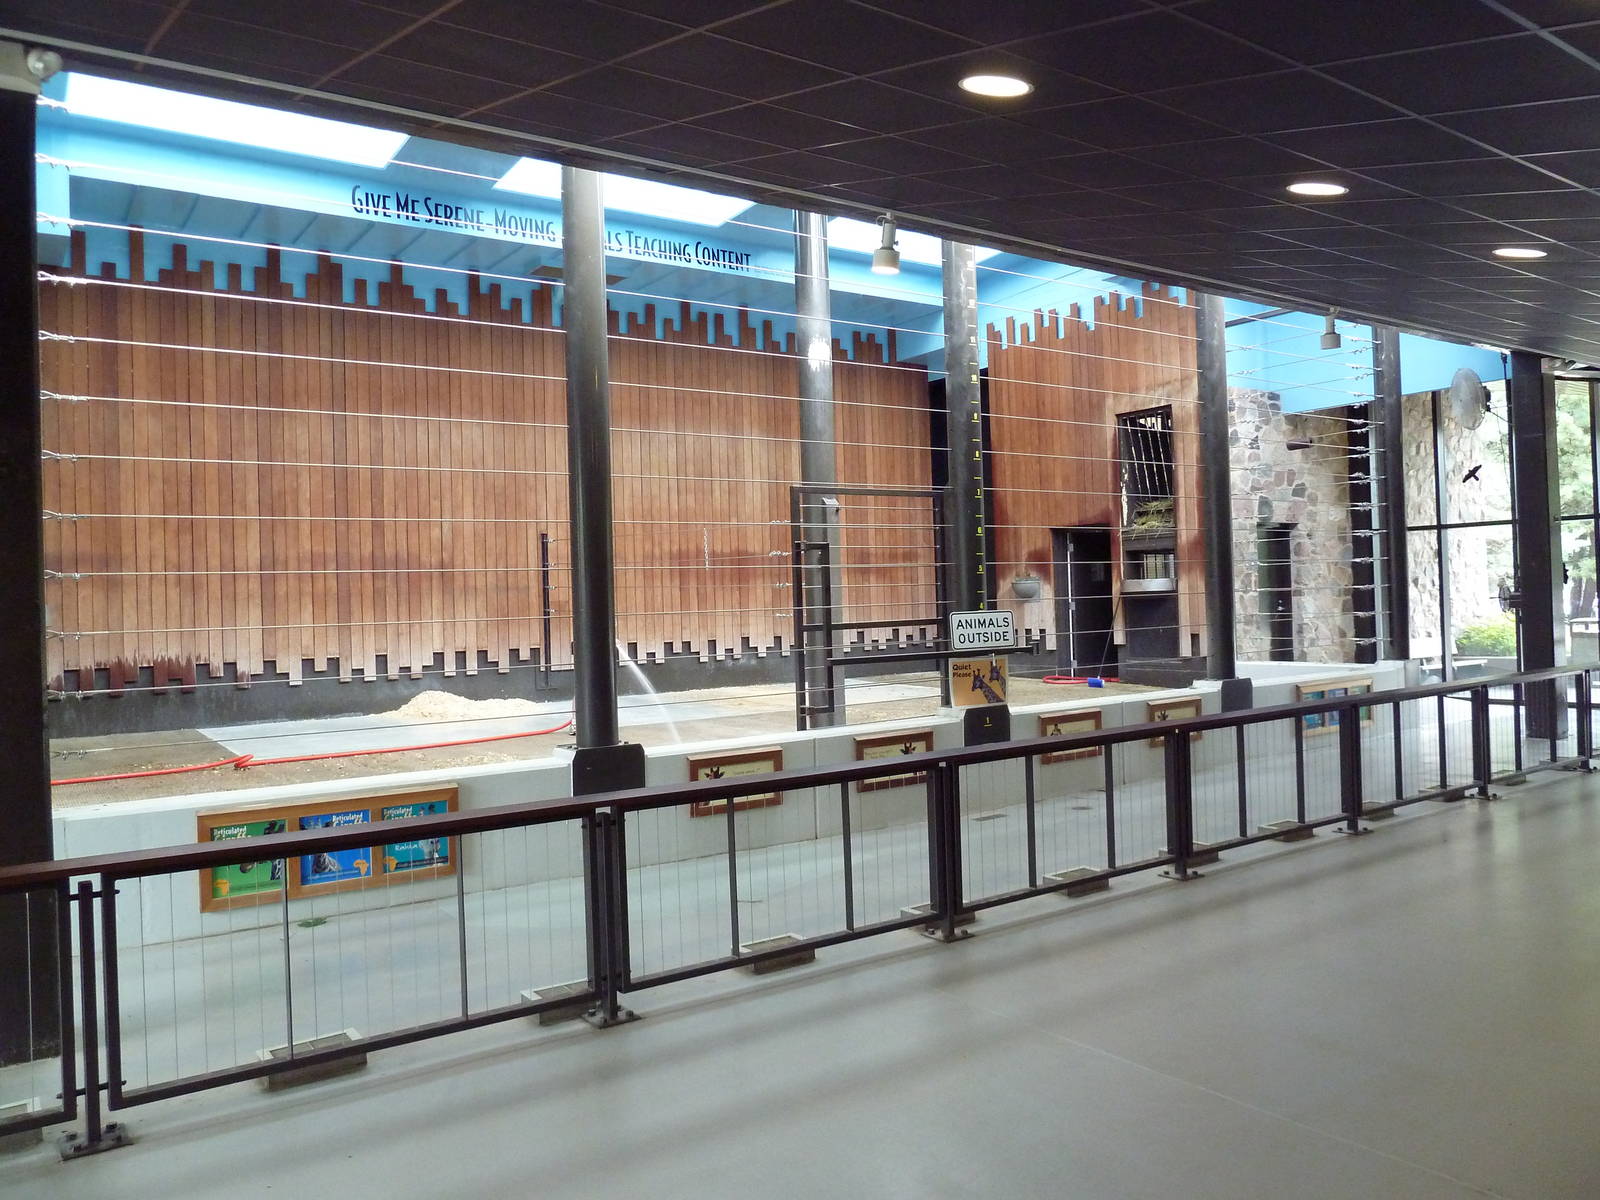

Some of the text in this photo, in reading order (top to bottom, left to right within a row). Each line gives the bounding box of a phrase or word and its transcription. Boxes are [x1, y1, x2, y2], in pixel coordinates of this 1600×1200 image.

[351, 185, 391, 217] GIVE
[395, 192, 420, 221] ME
[625, 230, 692, 264] TEACHING
[694, 241, 752, 273] CONTENT
[956, 617, 1010, 630] ANIMALS
[958, 631, 1010, 644] OUTSIDE
[332, 812, 363, 823] Reticulated
[213, 825, 247, 838] Reticulated
